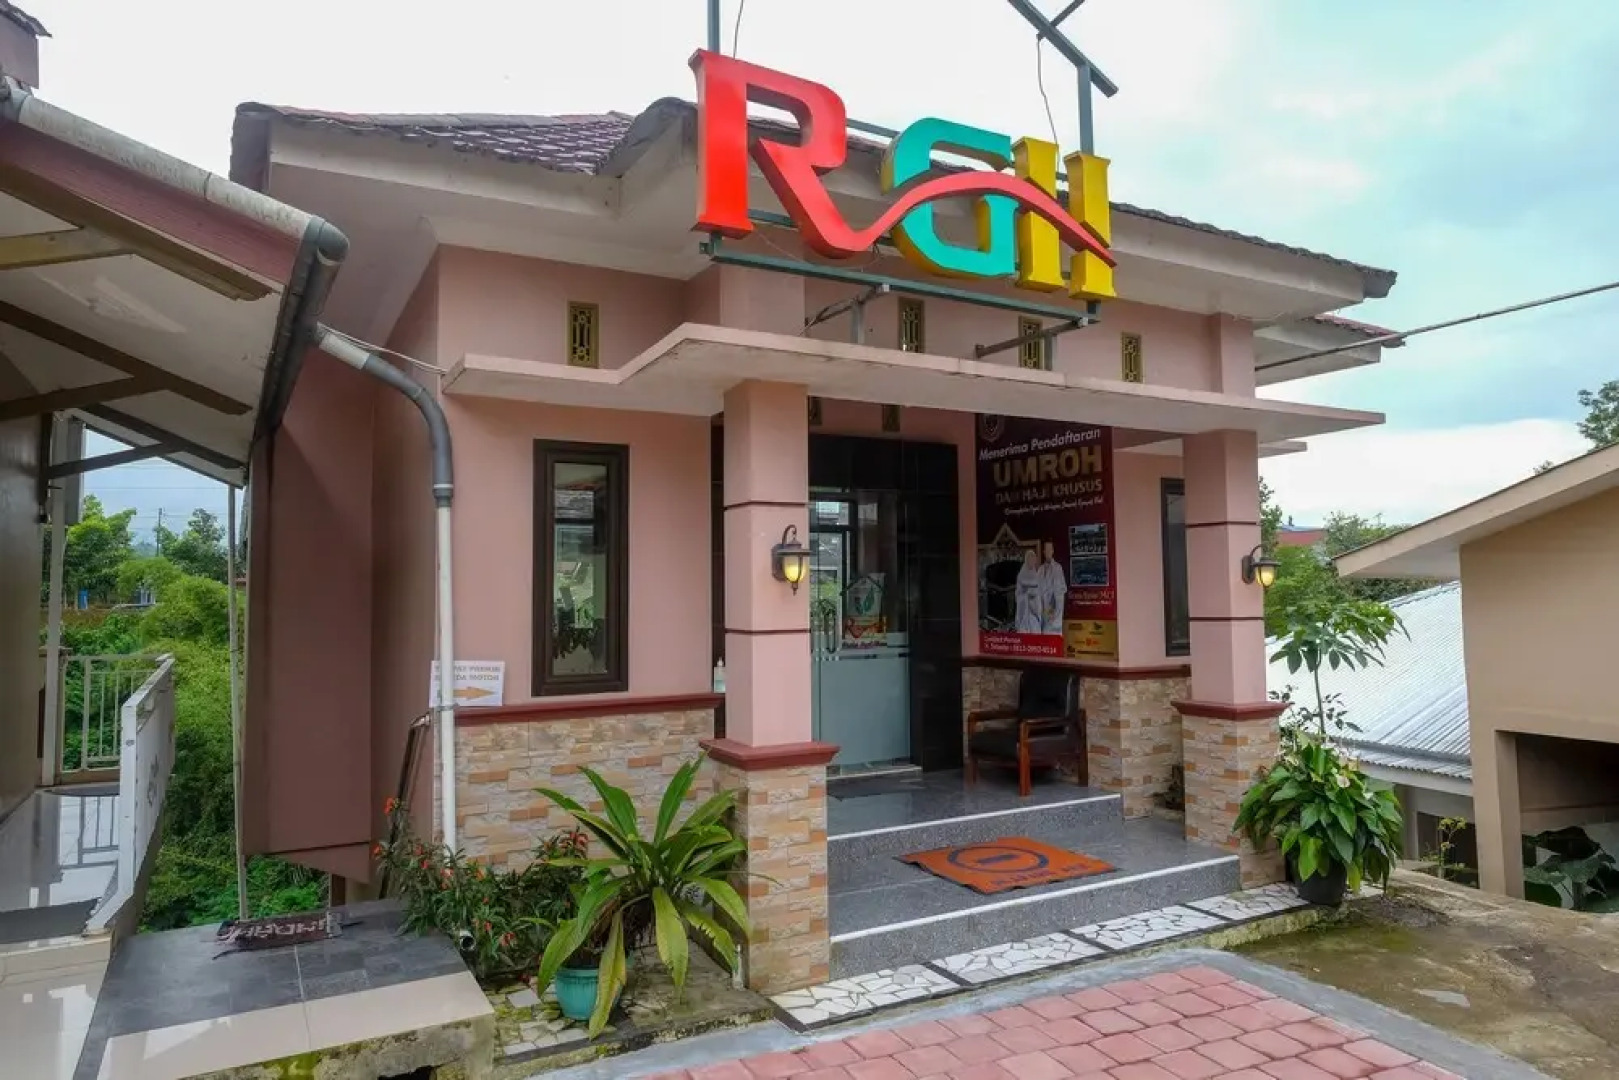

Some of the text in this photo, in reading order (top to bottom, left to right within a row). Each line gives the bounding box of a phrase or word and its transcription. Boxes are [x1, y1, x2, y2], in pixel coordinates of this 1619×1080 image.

[979, 428, 1101, 461] Menerima Pendaftaran
[993, 444, 1103, 488] UMROH
[1053, 478, 1102, 498] KHUSUS
